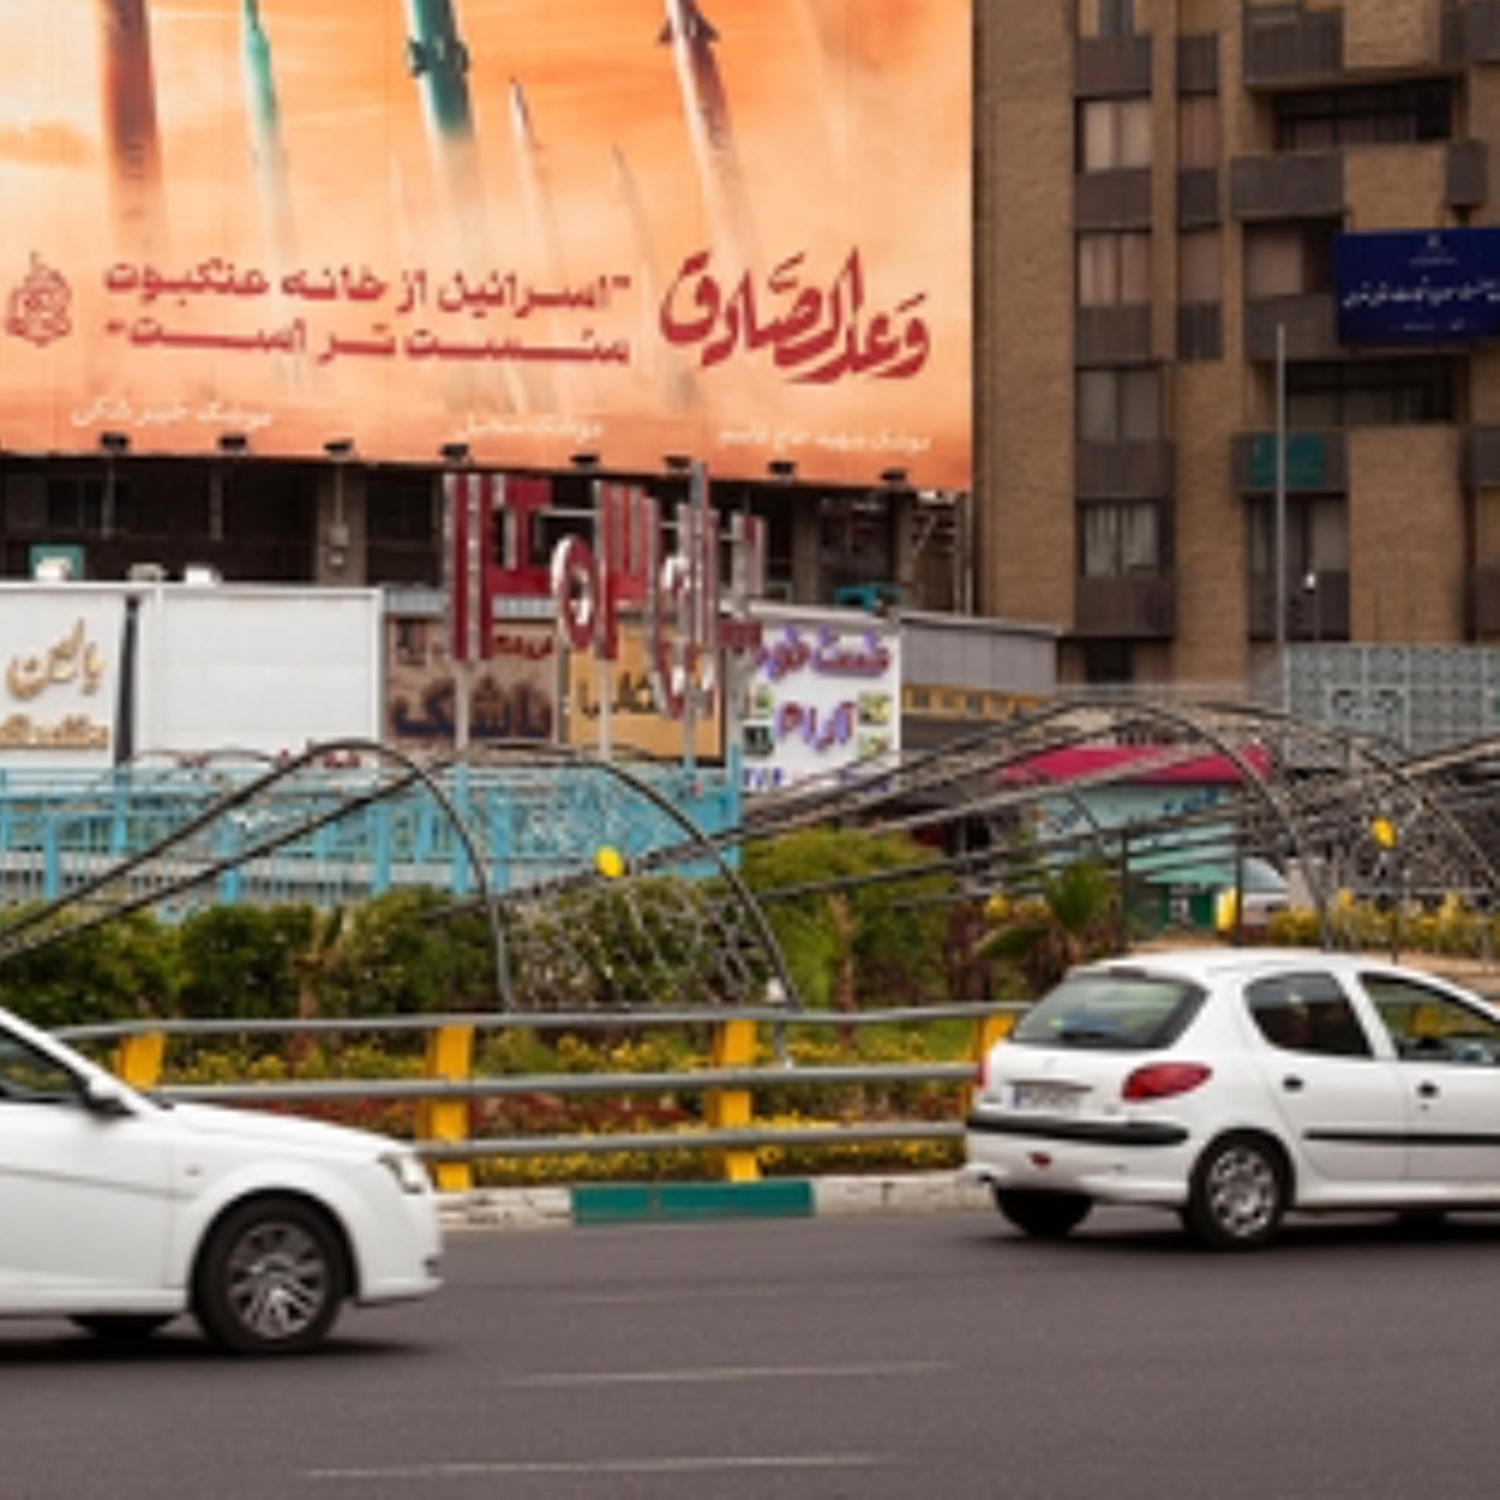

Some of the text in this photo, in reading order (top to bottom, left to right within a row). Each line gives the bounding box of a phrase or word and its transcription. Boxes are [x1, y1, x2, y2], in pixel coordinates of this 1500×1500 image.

[104, 256, 271, 308] عنکبوت
[281, 265, 389, 302] خانه
[396, 269, 427, 314] از
[197, 399, 271, 432] موشک
